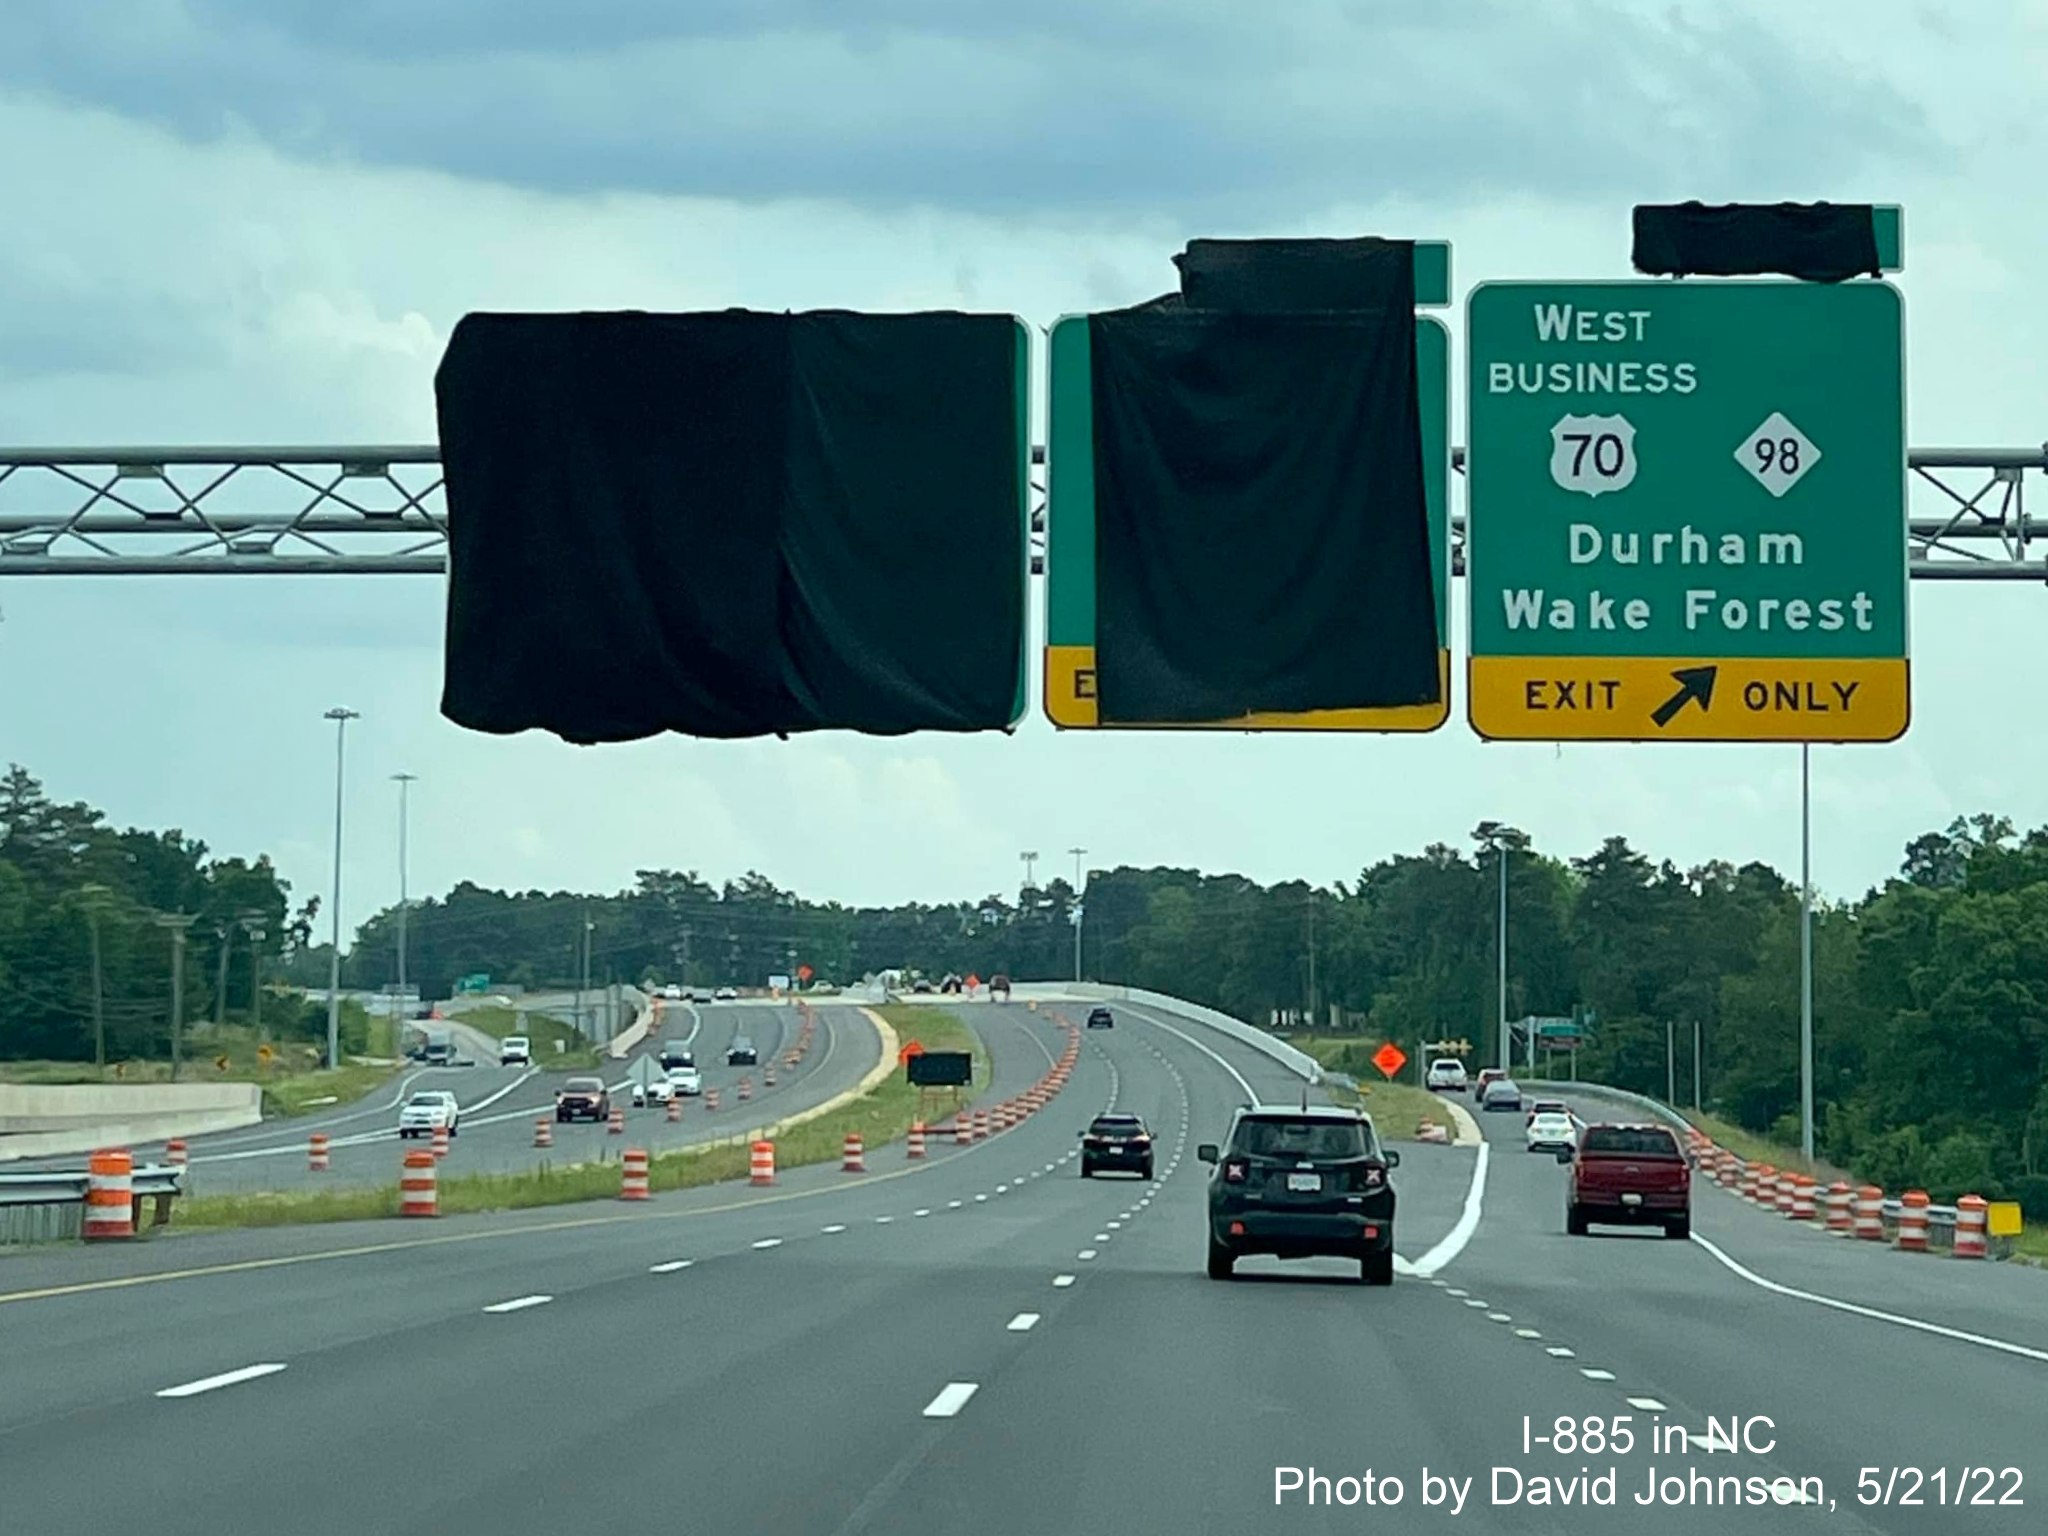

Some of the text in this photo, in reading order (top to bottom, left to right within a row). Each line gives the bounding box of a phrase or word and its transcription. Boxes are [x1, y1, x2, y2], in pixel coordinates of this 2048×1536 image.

[1535, 304, 1650, 342] WEST
[1490, 362, 1697, 393] BUSINESS
[1561, 433, 1625, 478] 70
[1754, 437, 1800, 476] 98
[1569, 524, 1803, 564] Durham
[1502, 589, 1873, 630] Wake Forest
[1525, 680, 1860, 712] EXIT ONLY
